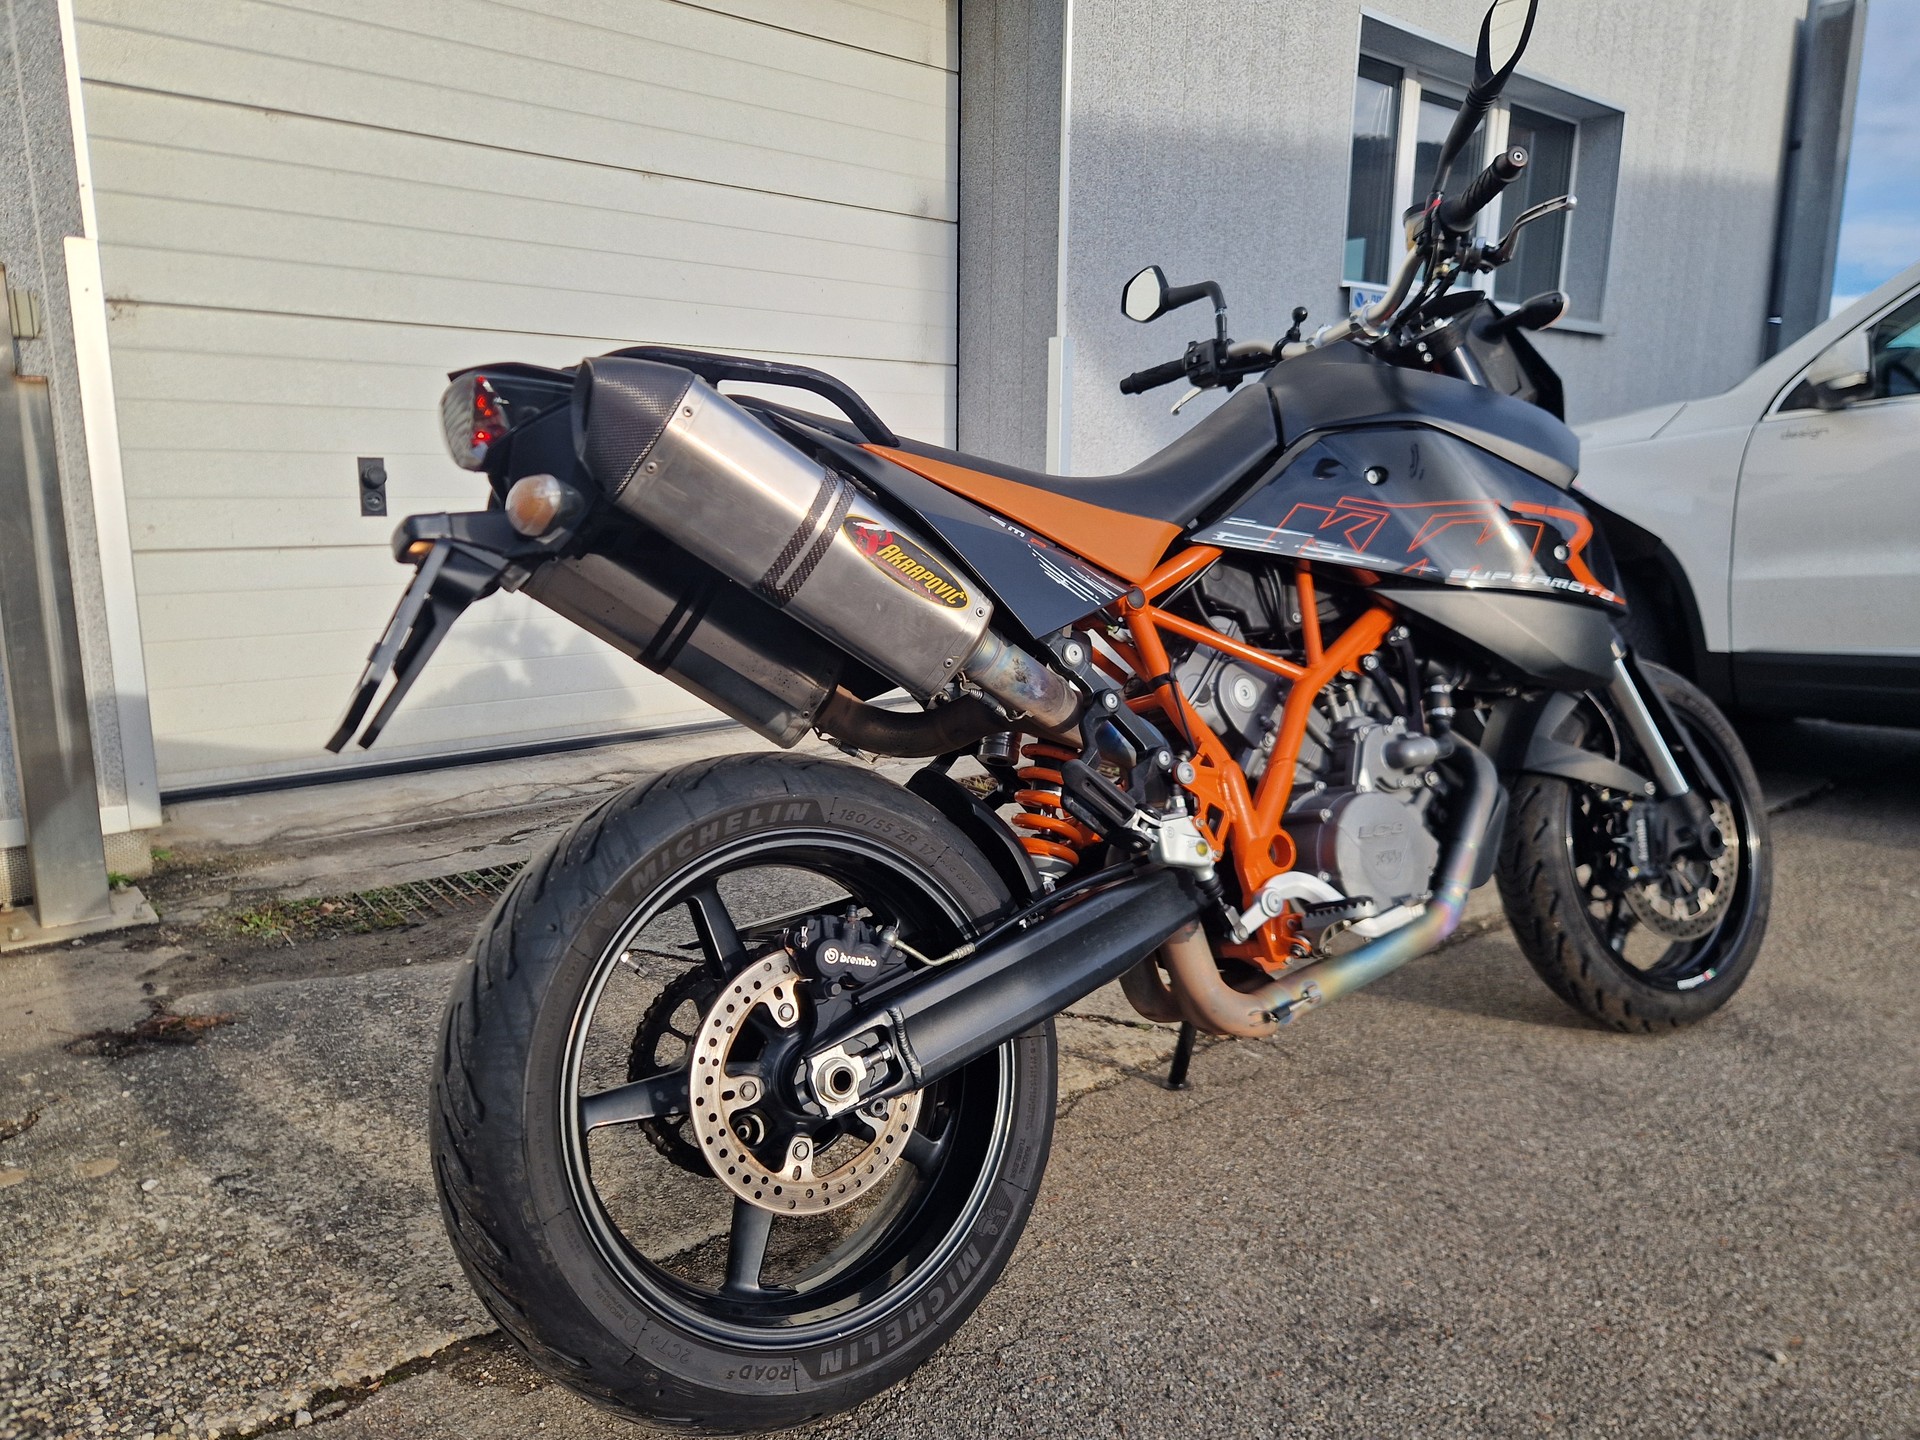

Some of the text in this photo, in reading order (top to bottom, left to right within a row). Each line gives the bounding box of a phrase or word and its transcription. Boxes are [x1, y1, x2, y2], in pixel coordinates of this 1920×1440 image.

[630, 803, 812, 895] MICHELIN
[839, 808, 937, 857] 180/55 ZR 17
[839, 951, 878, 968] brembo
[819, 1242, 982, 1376] MICHELIN
